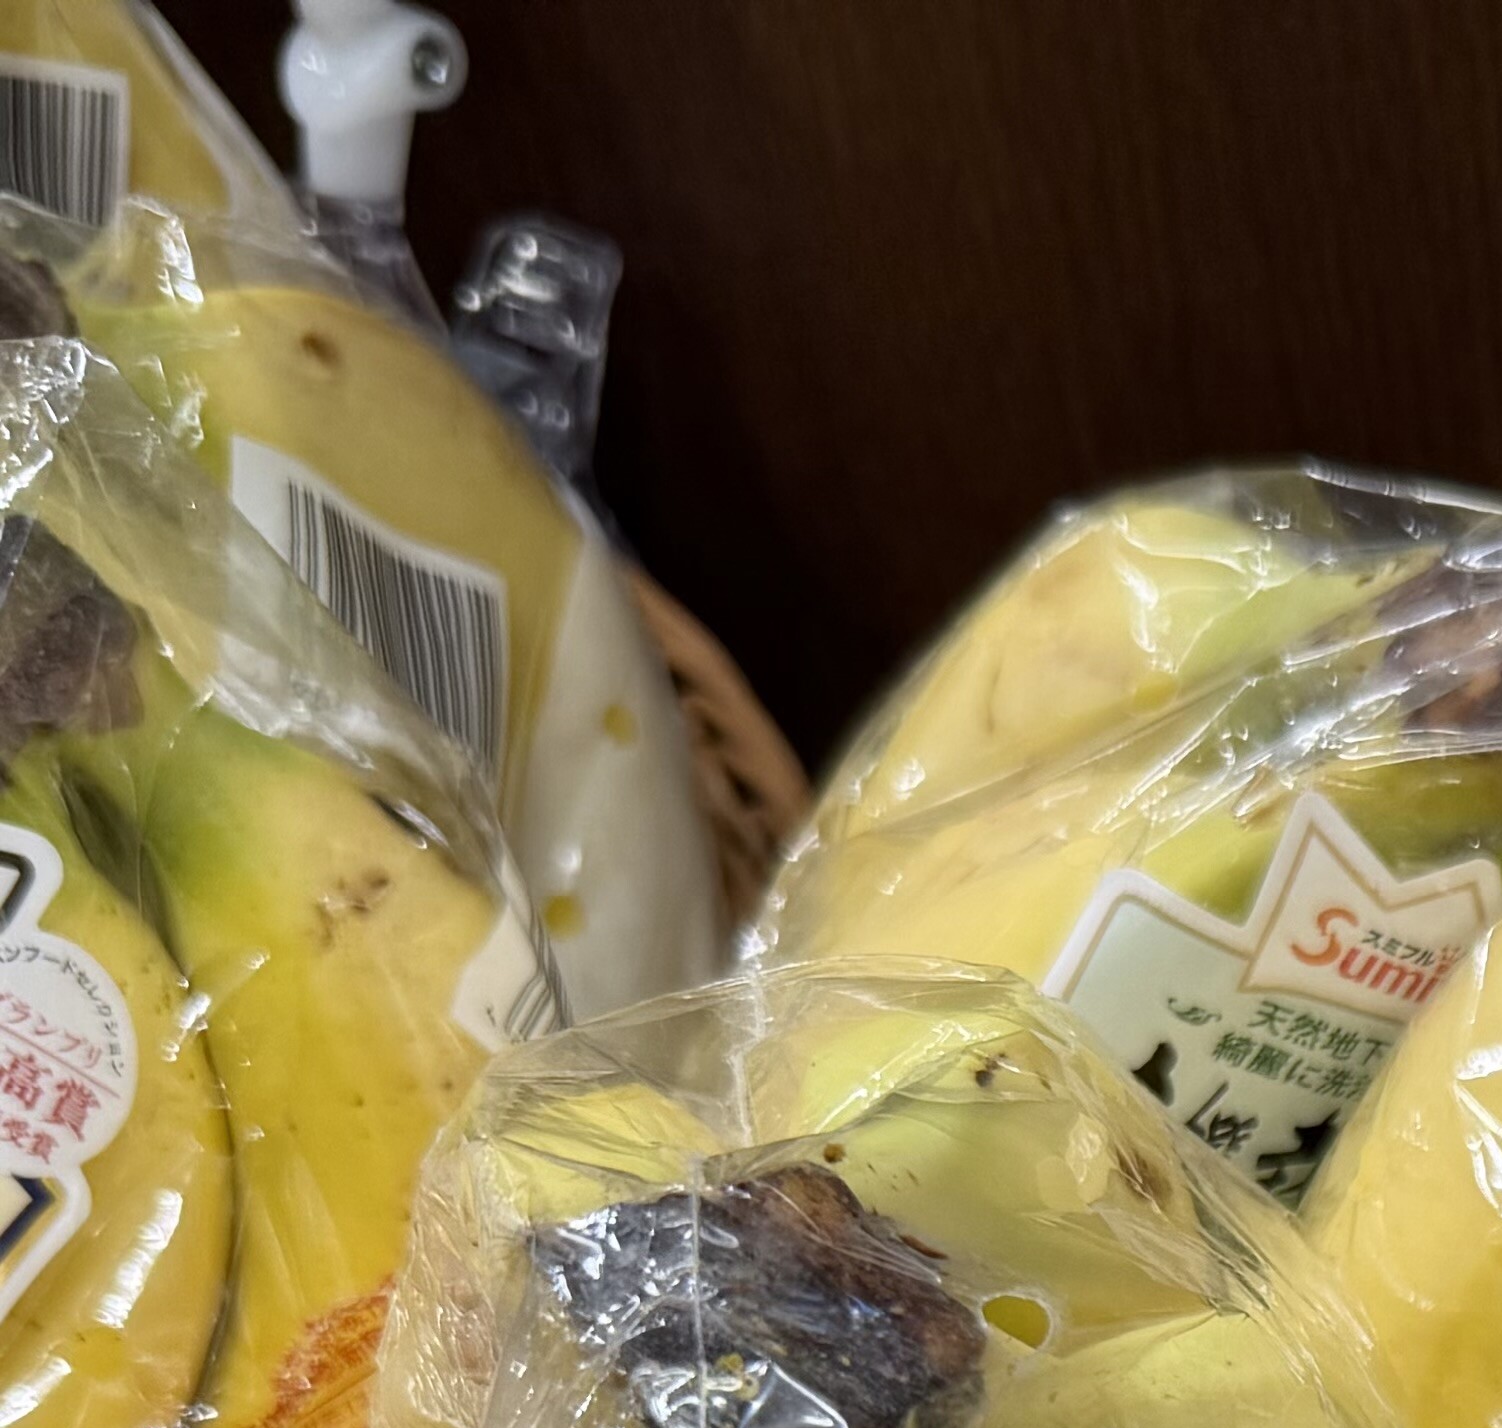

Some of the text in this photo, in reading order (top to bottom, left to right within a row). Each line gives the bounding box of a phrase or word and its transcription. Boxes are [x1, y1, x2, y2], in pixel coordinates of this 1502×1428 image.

[1361, 928, 1438, 967] スミフル
[0, 940, 125, 1078] ンフードセレクション
[0, 1050, 102, 1143] 高賞
